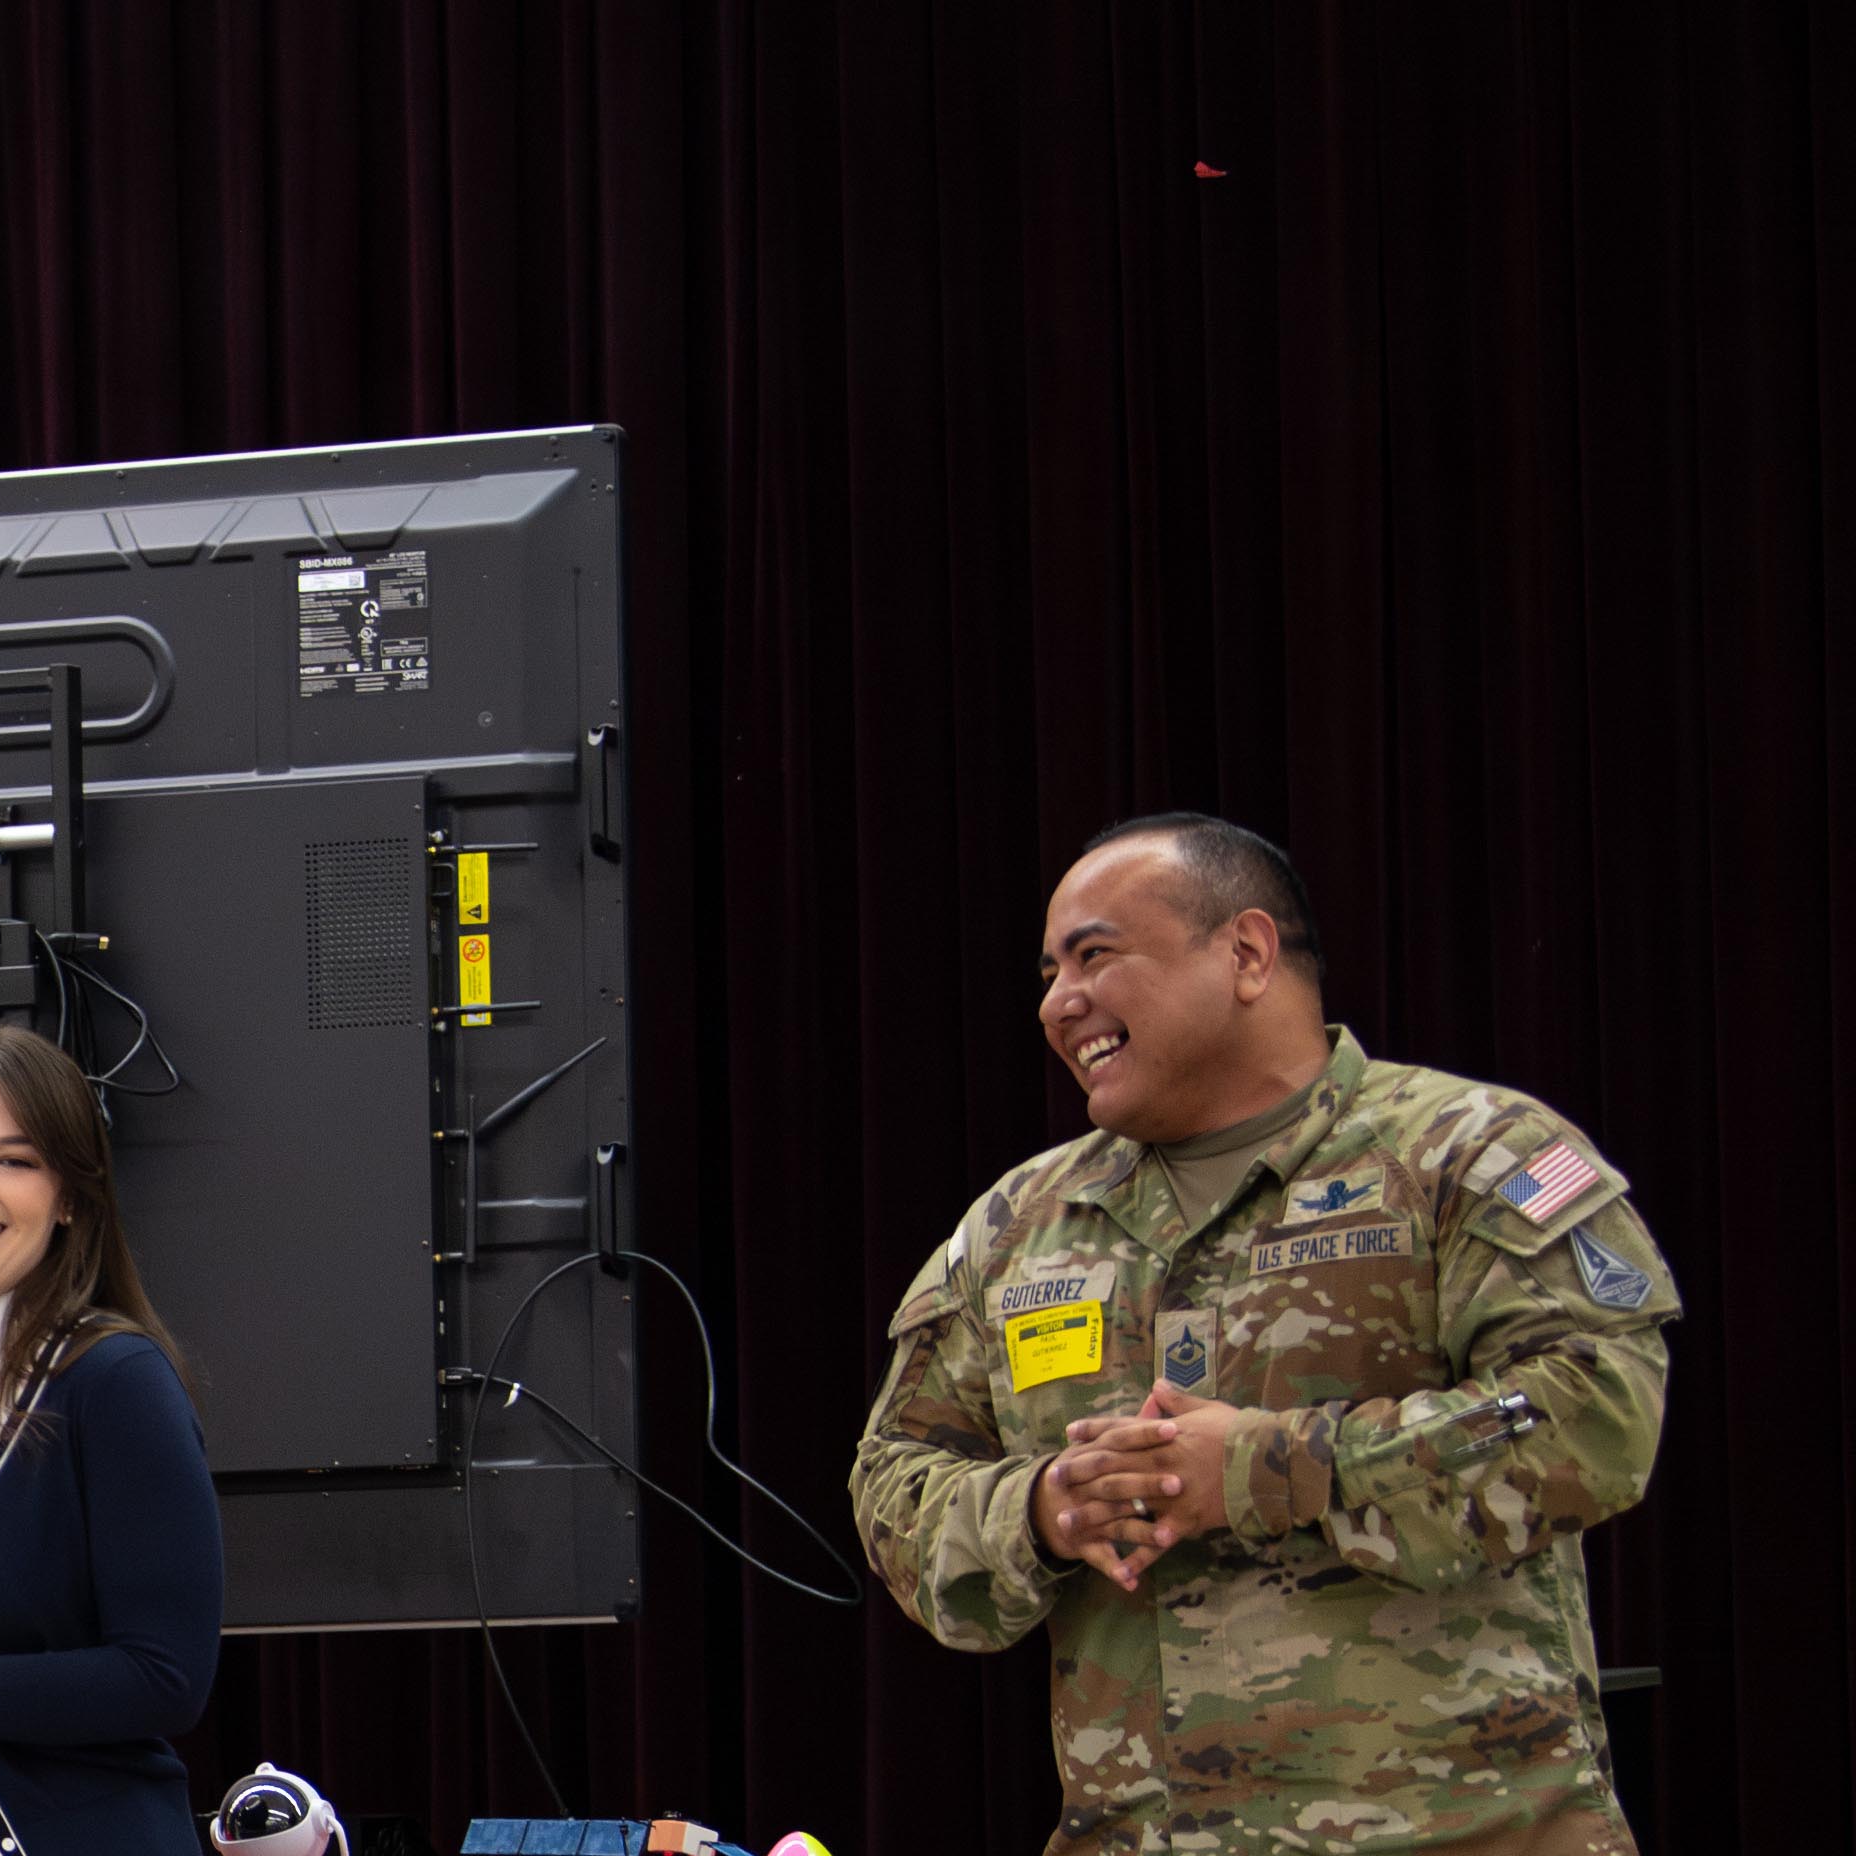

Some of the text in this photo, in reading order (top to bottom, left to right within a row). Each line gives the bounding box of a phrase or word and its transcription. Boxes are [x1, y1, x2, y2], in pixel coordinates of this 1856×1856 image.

[1257, 1228, 1400, 1271] U.S. SPACE FORCE
[1001, 1278, 1087, 1310] GUTIERREZ
[1087, 1317, 1099, 1359] Friday
